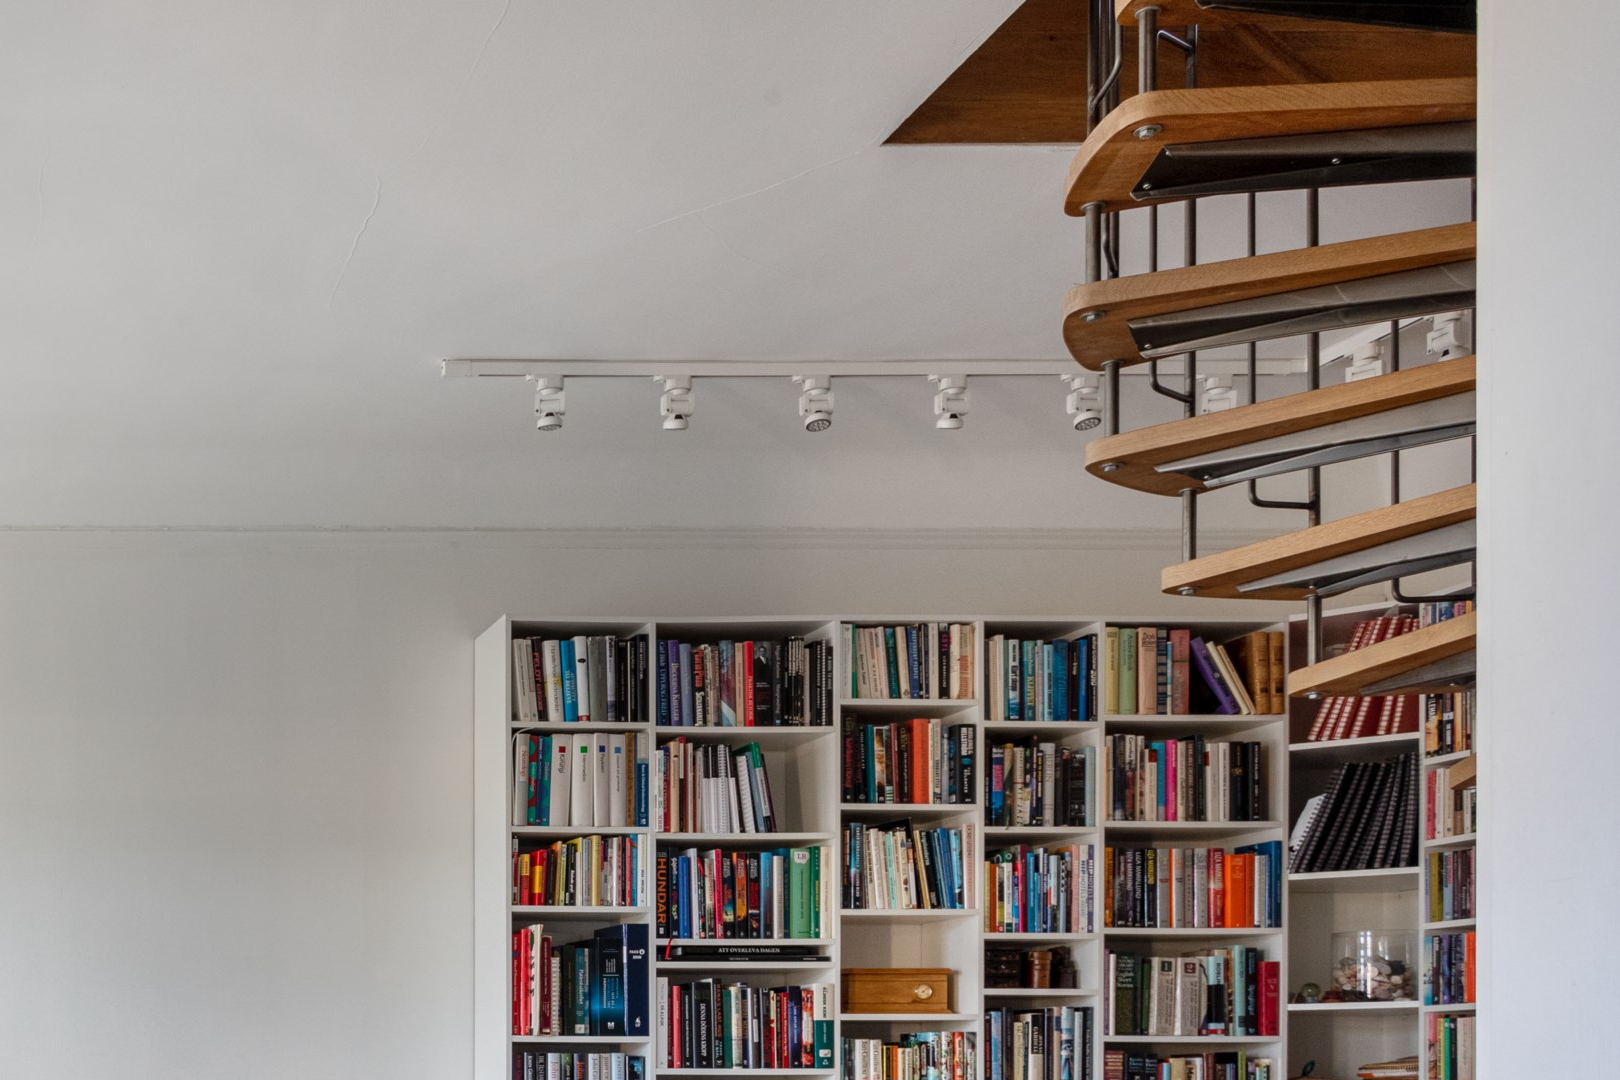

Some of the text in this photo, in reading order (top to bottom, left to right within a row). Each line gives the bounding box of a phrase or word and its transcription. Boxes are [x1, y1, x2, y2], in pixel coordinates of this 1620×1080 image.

[1045, 753, 1053, 782] BERLIN
[657, 859, 667, 923] HUNDAR
[551, 1060, 559, 1077] John
